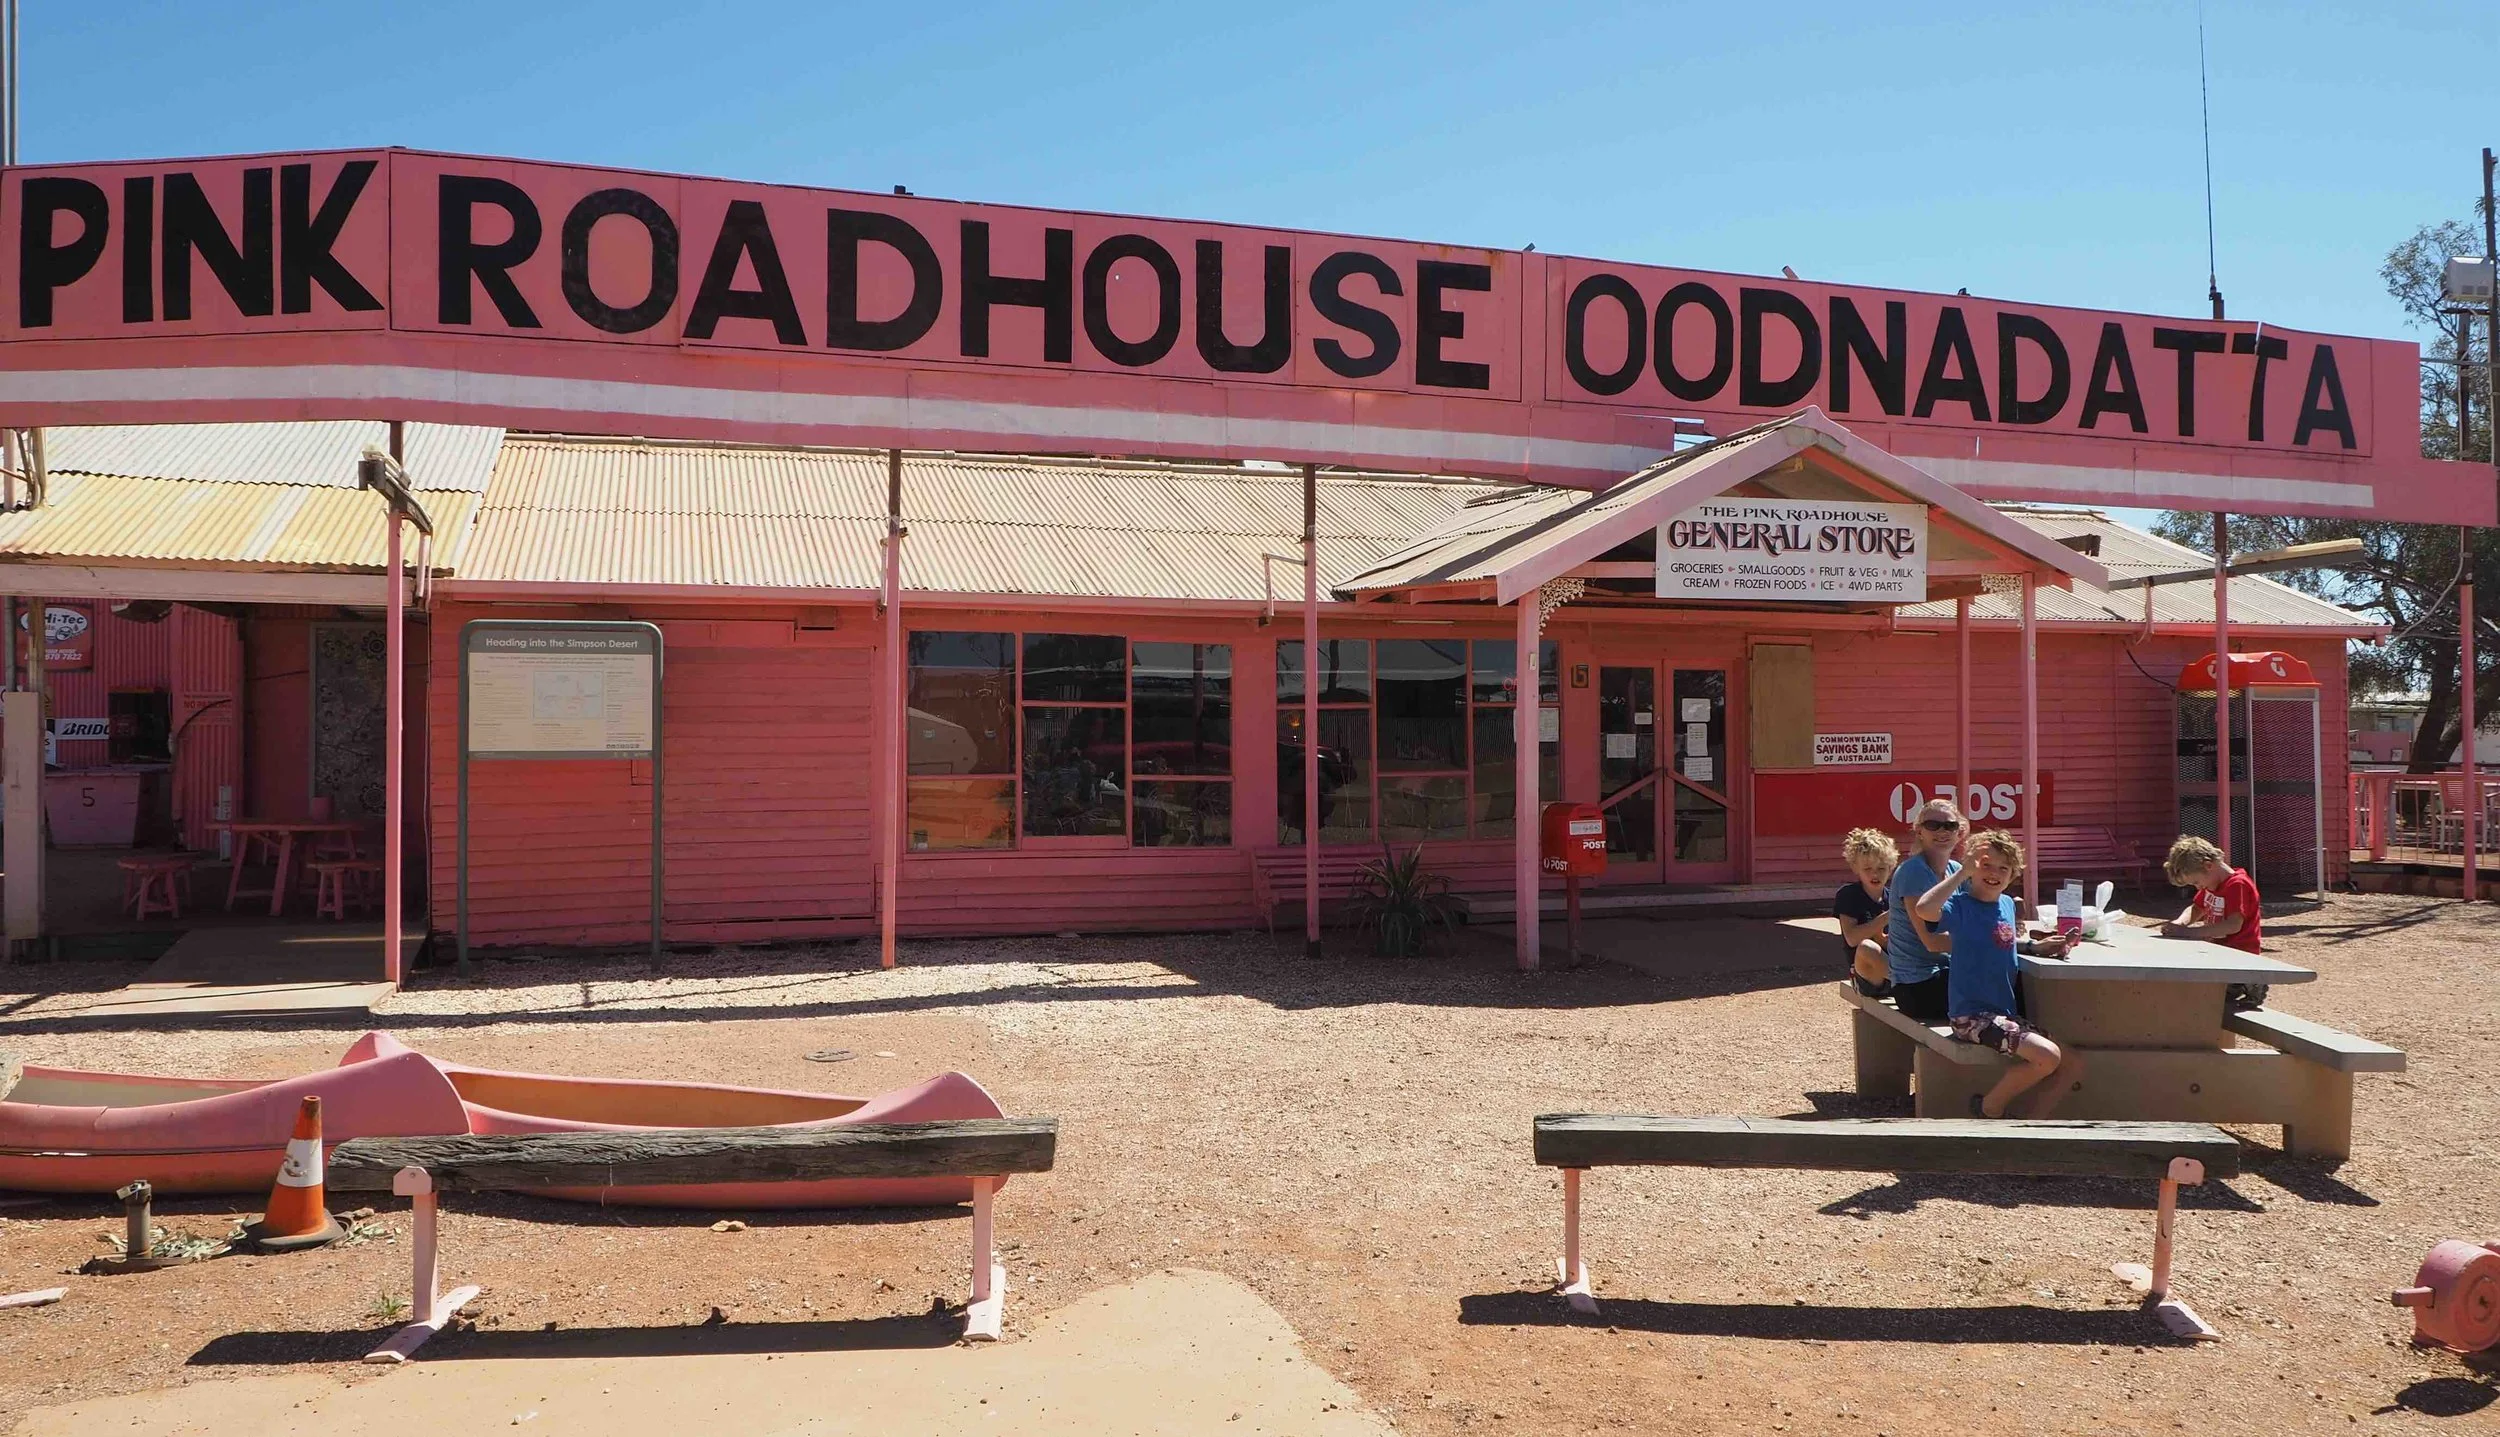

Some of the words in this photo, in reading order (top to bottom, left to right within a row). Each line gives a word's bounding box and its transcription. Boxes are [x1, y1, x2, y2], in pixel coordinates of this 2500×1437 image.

[20, 160, 385, 328] PINK
[438, 173, 1491, 389] ROADHOUSE
[1565, 273, 2358, 450] OODNADATTA
[1700, 506, 1738, 517] THE
[1743, 508, 1783, 521] PINK
[1785, 509, 1888, 522] ROADHOUSE
[1667, 520, 1811, 556] GENERAL
[1817, 525, 1915, 561] STORE
[1670, 563, 1724, 574] GROCERIES
[1738, 565, 1806, 576] SMALLGOODS
[1819, 566, 1845, 577] FRUIT
[1848, 567, 1857, 577] &
[1859, 567, 1879, 578] VEG
[1891, 568, 1913, 578] MILK
[1683, 578, 1720, 588] CREAM
[1734, 579, 1771, 589] FROZEN
[1774, 579, 1807, 590] FOODS
[1820, 581, 1835, 590] ICE
[1848, 581, 1872, 591] 4WD
[1875, 582, 1903, 591] PARTS
[486, 638, 527, 648] Heading
[529, 639, 547, 648] into
[549, 639, 565, 648] the
[567, 639, 607, 650] Simpson
[609, 640, 638, 649] Desert
[1816, 744, 1859, 754] SAVINGS
[1861, 744, 1890, 754] BANK
[1837, 754, 1883, 762] AUSTRALIA
[82, 787, 96, 807] 5
[1583, 841, 1606, 849] POST
[1551, 860, 1568, 871] POST
